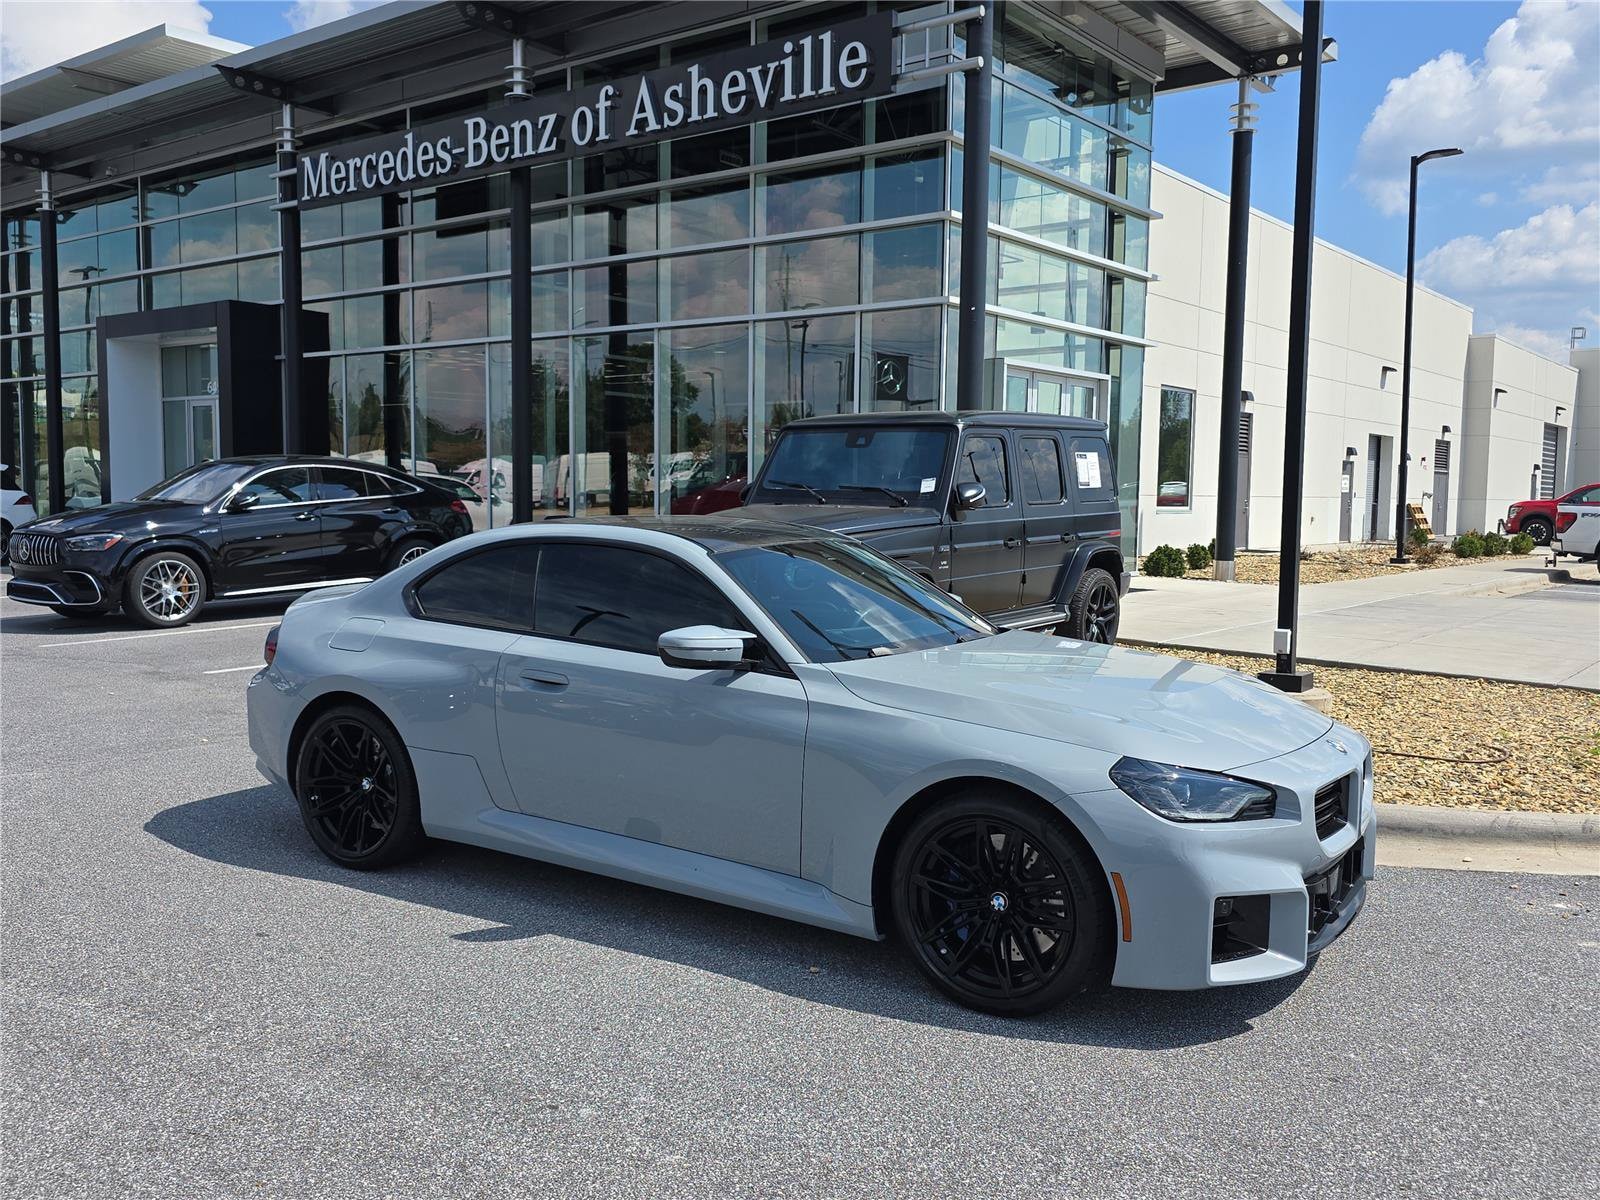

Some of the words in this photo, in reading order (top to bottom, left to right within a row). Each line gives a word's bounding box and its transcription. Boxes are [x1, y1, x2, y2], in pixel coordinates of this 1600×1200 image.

[302, 113, 557, 200] Mercedes-Benz
[571, 85, 614, 146] of
[626, 31, 868, 136] Asheville
